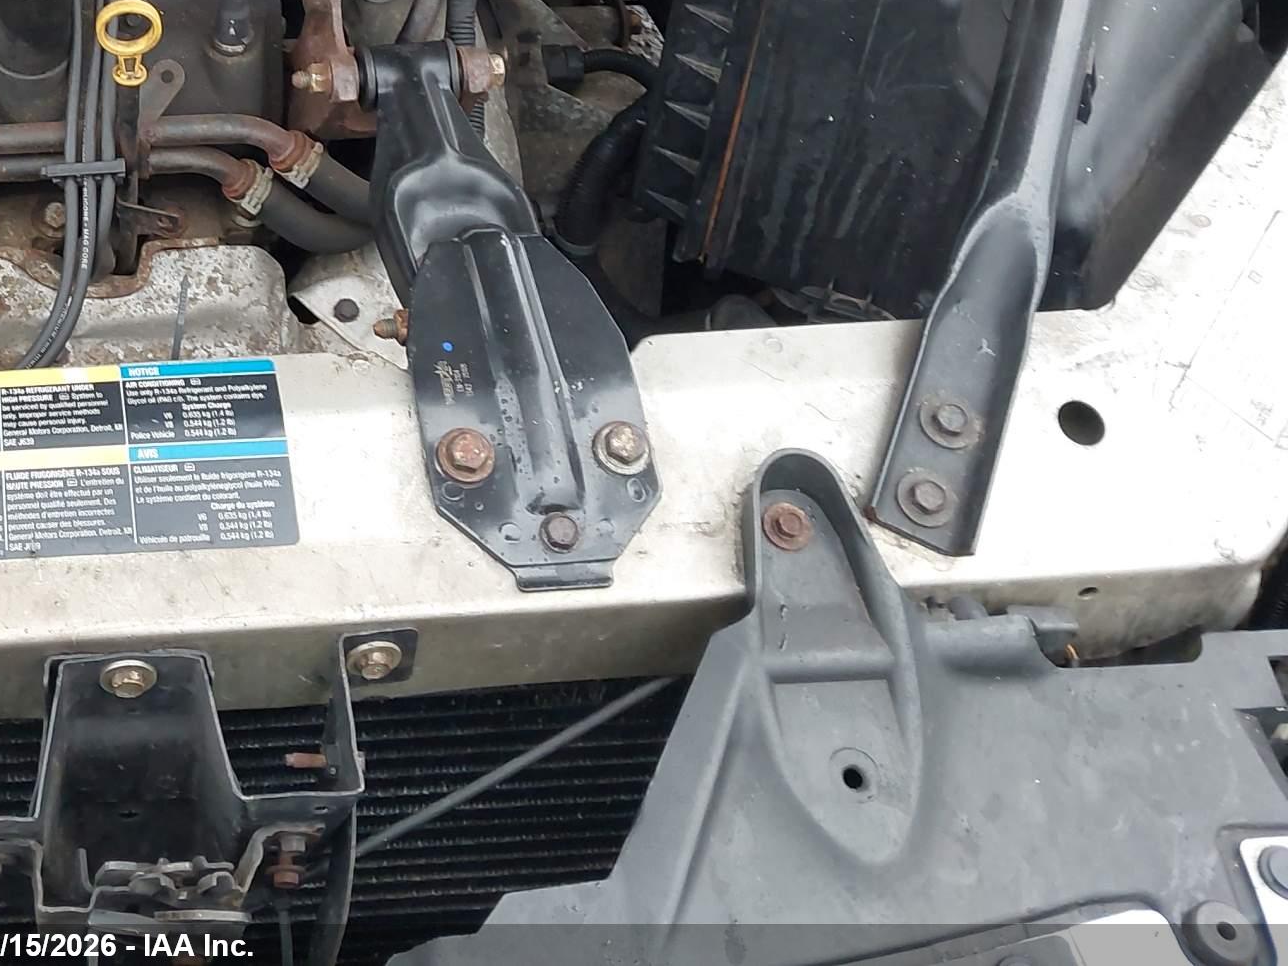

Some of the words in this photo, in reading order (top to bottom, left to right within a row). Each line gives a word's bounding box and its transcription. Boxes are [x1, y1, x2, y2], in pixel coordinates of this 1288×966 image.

[81, 247, 89, 269] CORE
[128, 367, 159, 376] NOTICE
[138, 379, 185, 388] CONDITIONING
[25, 385, 70, 394] REFRIGERANT
[126, 389, 138, 397] Use
[140, 389, 153, 397] only
[178, 386, 214, 395] Refrigerant
[227, 384, 267, 392] Polyalkylene
[19, 394, 53, 402] PRESSURE
[71, 392, 95, 400] System
[127, 397, 147, 405] Glycol
[200, 394, 222, 402] system
[12, 403, 38, 411] serviced
[48, 401, 76, 410] qualified
[77, 400, 108, 408] personnel
[182, 402, 207, 411] System
[208, 402, 231, 410] Charge
[18, 411, 47, 419] Improper
[202, 410, 211, 418] kg
[38, 418, 66, 427] personal
[203, 420, 212, 428] kg
[151, 431, 175, 439] Vehicle
[204, 429, 213, 437] kg
[4, 438, 17, 447] SAE
[138, 449, 158, 459] AVIS
[134, 464, 179, 473] CLIMATISEUR
[6, 472, 29, 481] FLUIDE
[101, 467, 120, 475] SOUS
[158, 474, 192, 482] seulement
[6, 482, 29, 491] HAUTE
[30, 480, 64, 489] PRESSION
[7, 502, 39, 511] personnel
[210, 501, 236, 510] Charge
[237, 501, 245, 509] du
[238, 511, 247, 520] kg
[239, 521, 248, 530] kg
[9, 533, 33, 541] General
[240, 532, 249, 541] kg
[9, 542, 22, 551] SAE
